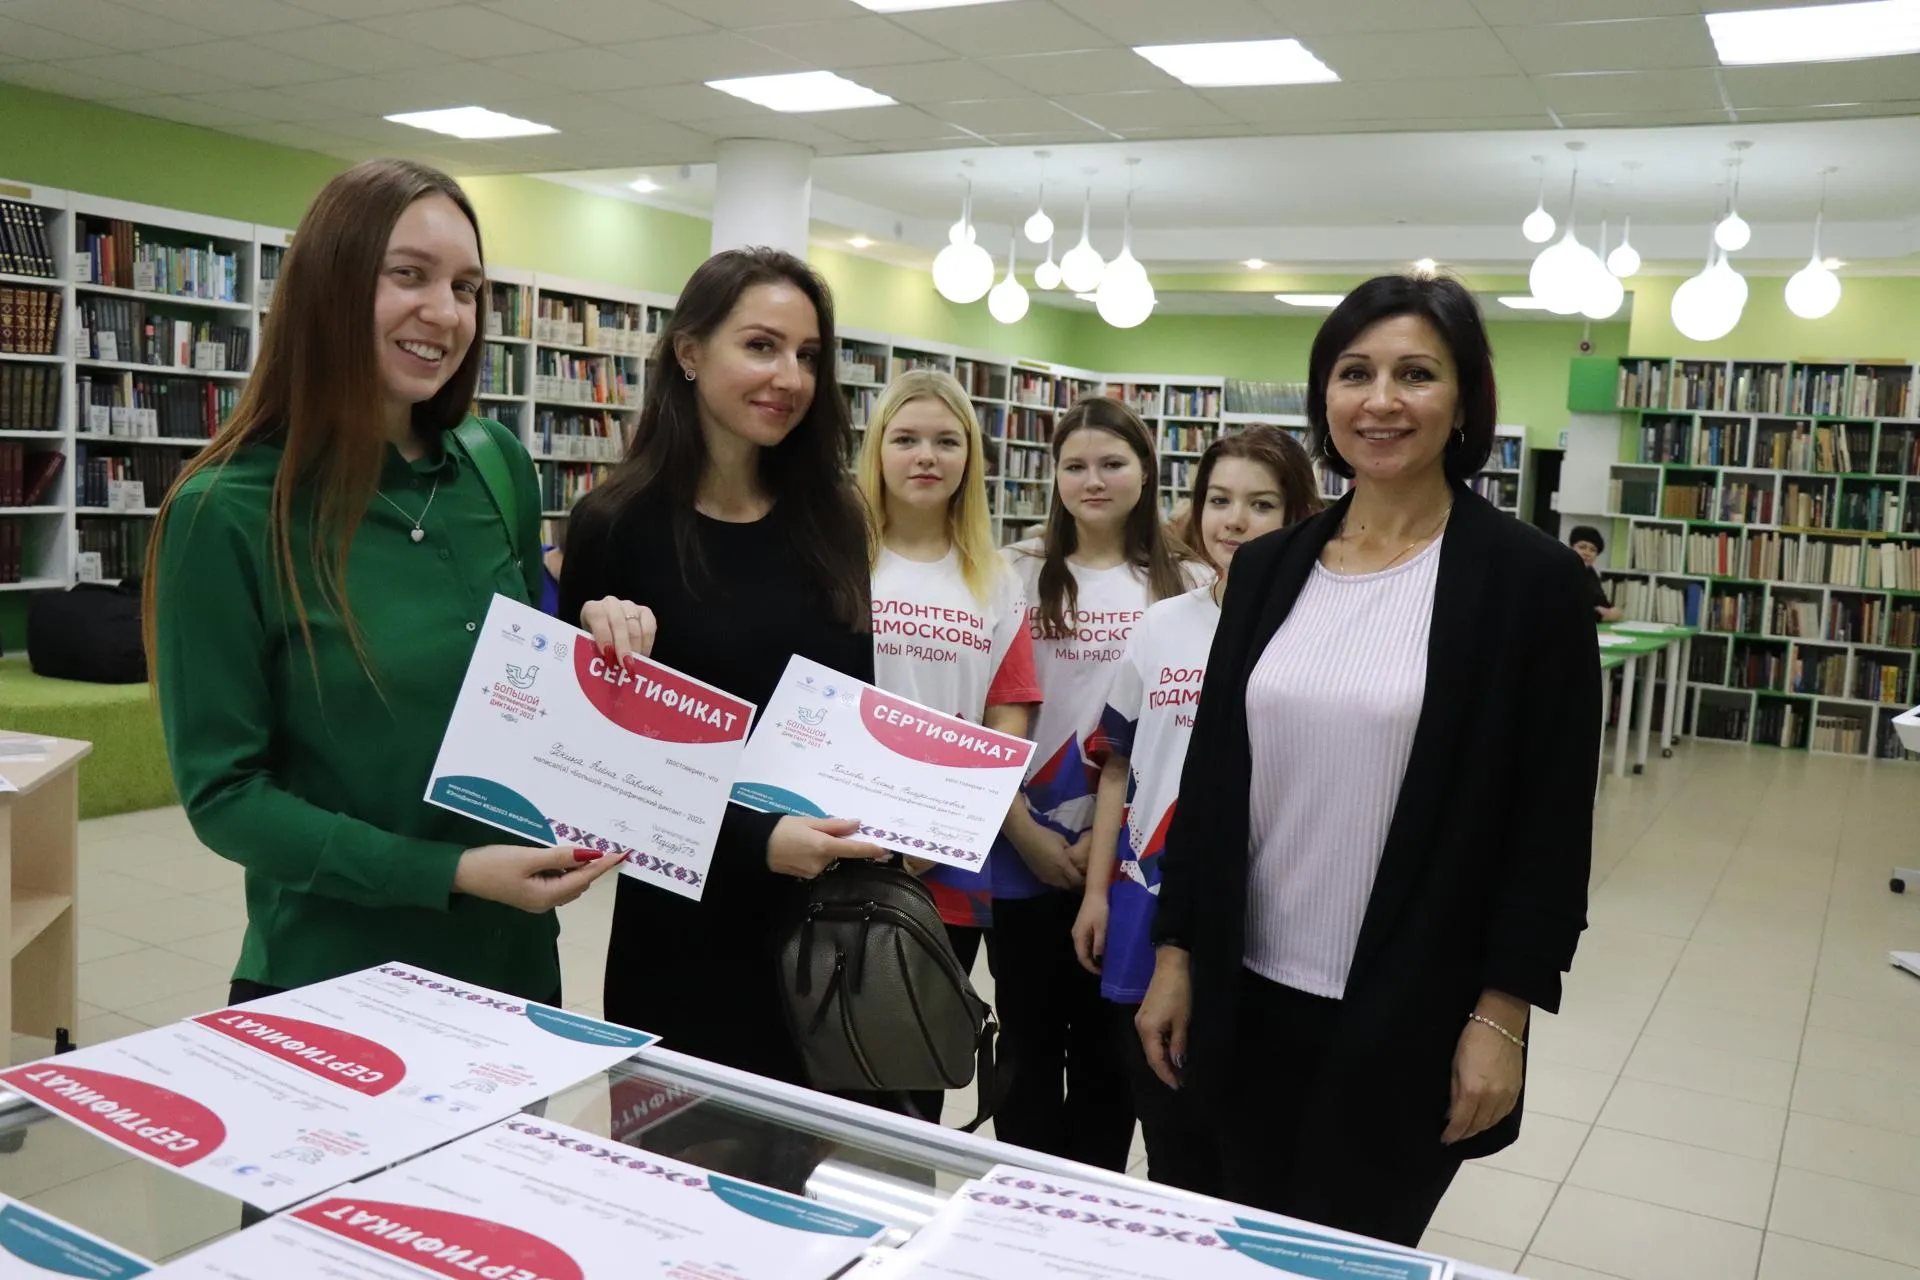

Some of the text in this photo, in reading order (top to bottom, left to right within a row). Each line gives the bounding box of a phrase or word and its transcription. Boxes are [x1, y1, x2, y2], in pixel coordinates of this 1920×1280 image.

[872, 599, 984, 631] ОЛОНТЕРЫ
[872, 618, 992, 655] ДМОСКОВЬЯ
[876, 642, 958, 664] МЫ РЯДОМ
[1055, 647, 1125, 663] МЫ РЯДО
[1159, 666, 1208, 686] ВОЛ
[494, 682, 539, 706] БОЛЬШОЙ
[1149, 688, 1201, 711] ПОДМ
[489, 698, 534, 720] ДИКТАНТ 2023
[872, 704, 1017, 762] СЕРТИФИКАТ
[218, 1015, 385, 1083] СЕРТИФИКАТ
[25, 1069, 200, 1152] СЕРТИФИКАТ
[322, 1205, 556, 1280] ЕРТИФИКАТ
